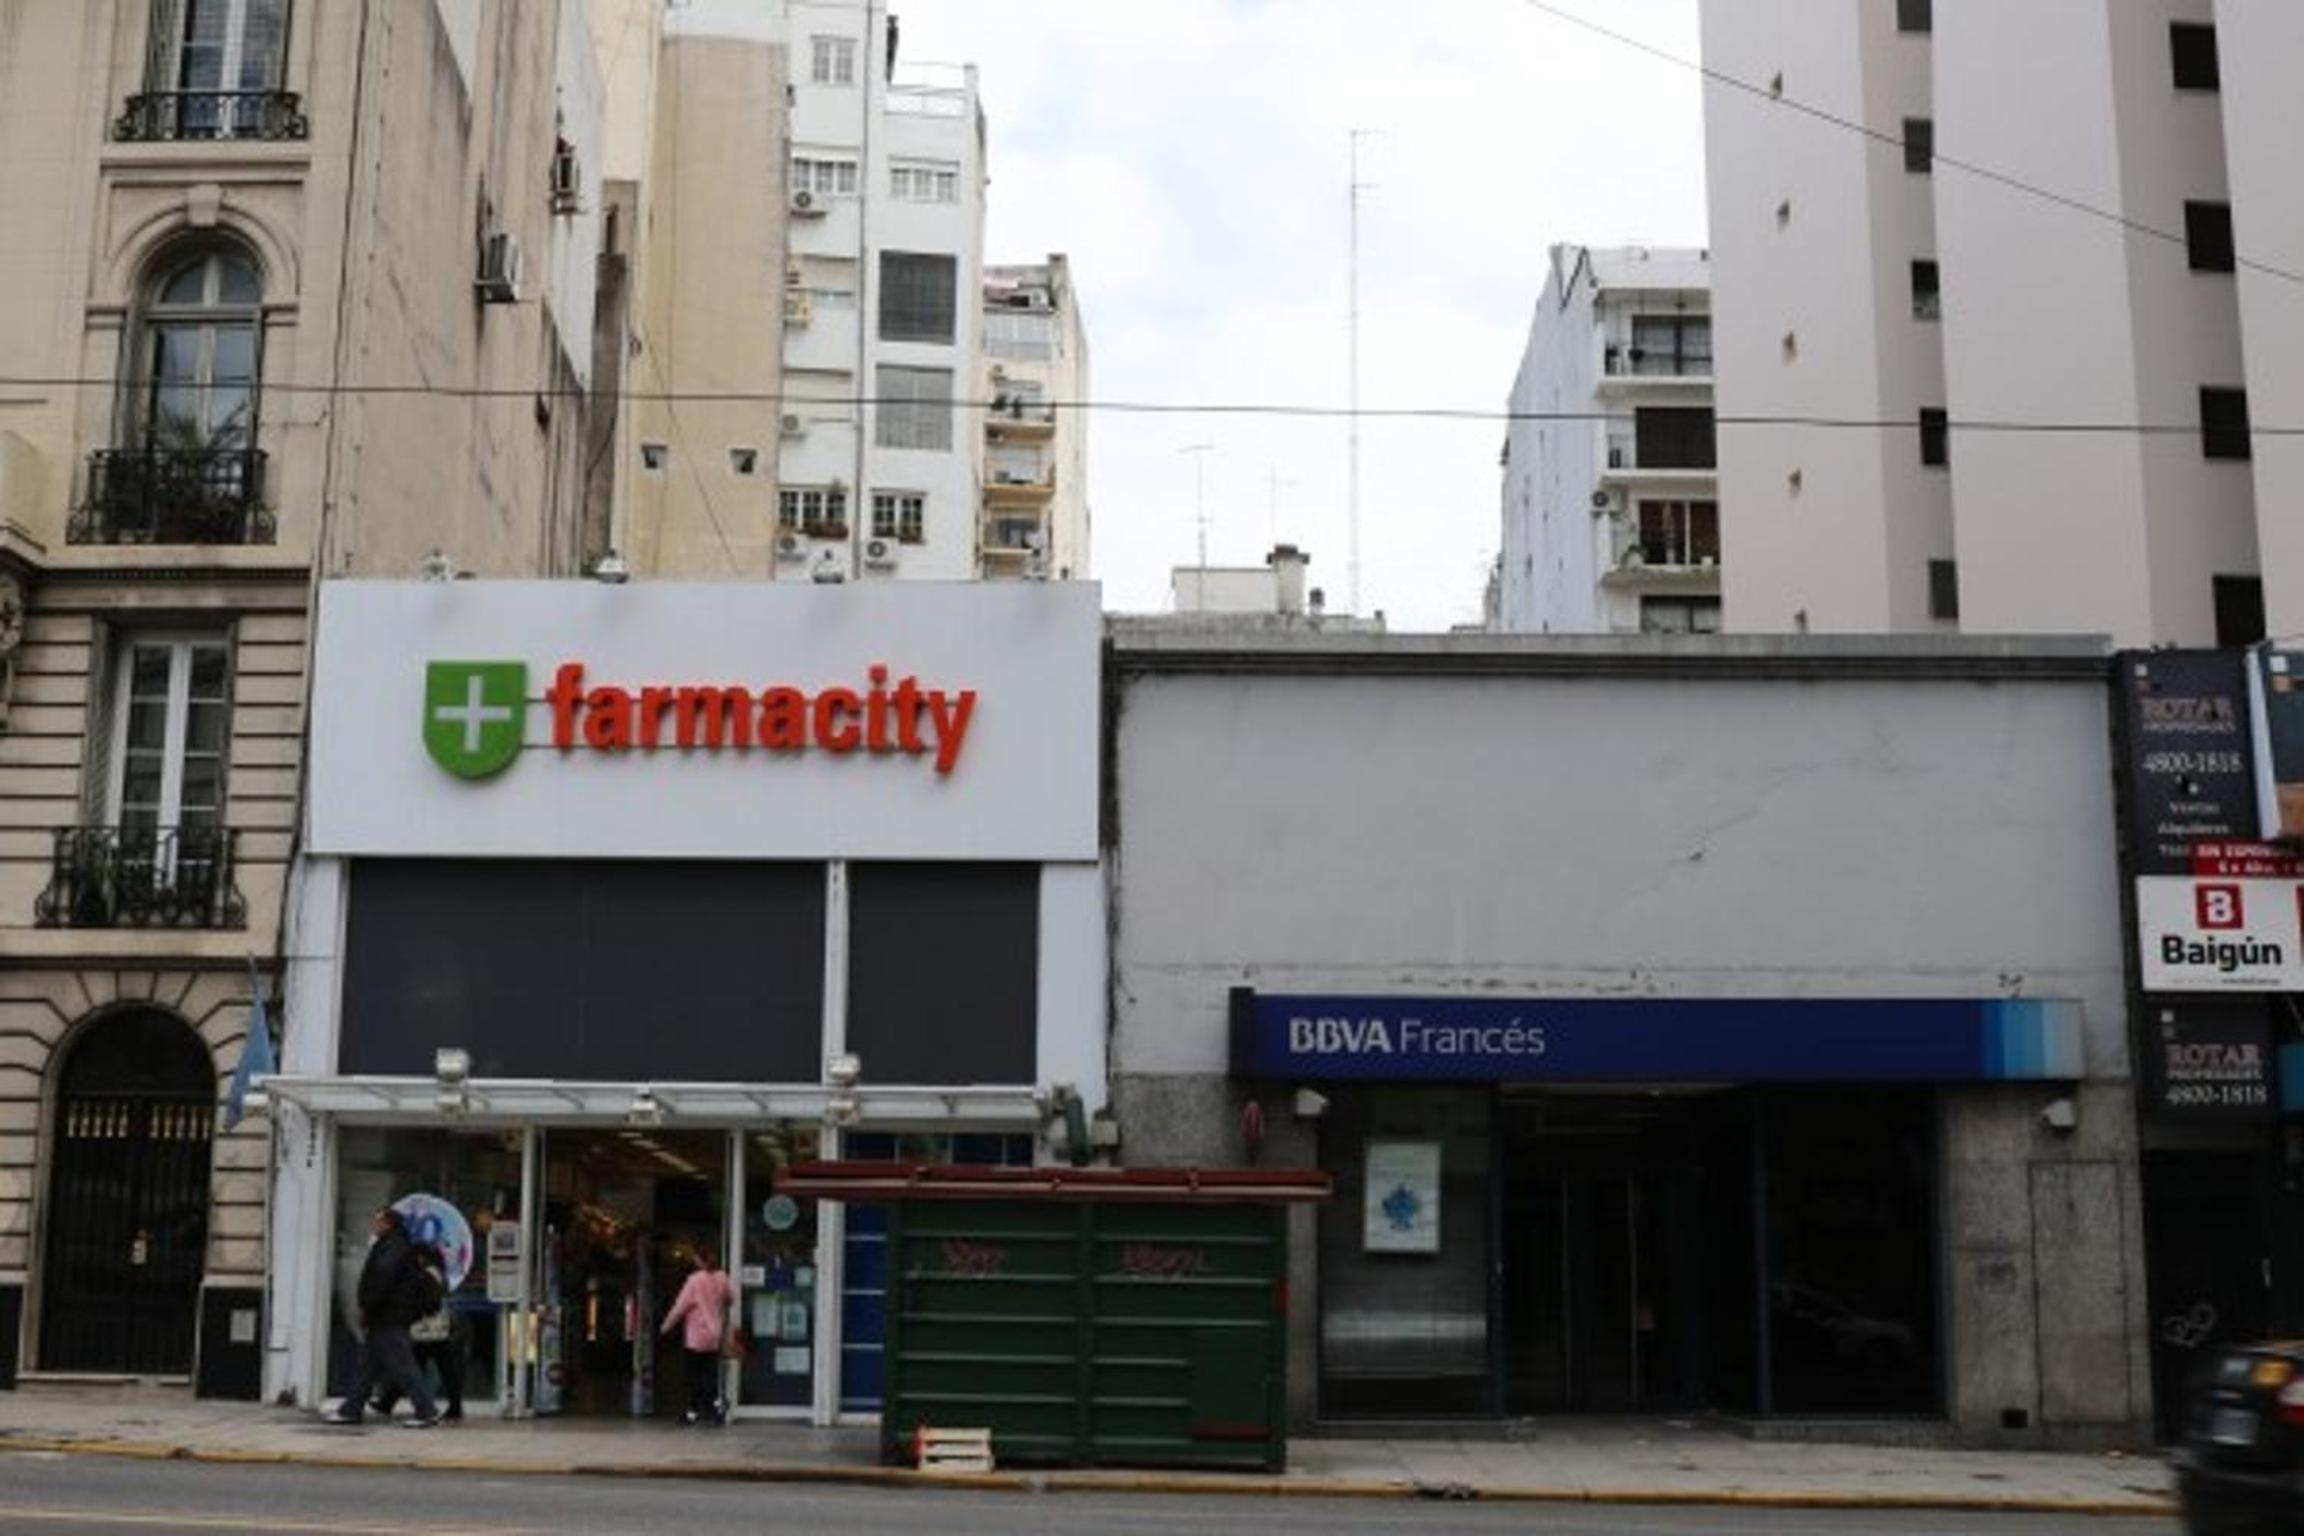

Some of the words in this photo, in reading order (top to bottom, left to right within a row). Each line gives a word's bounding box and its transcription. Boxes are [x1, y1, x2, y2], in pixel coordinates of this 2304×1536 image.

[547, 663, 977, 775] farmacity
[2207, 890, 2235, 923] B
[2161, 935, 2283, 971] Baigún
[1288, 1017, 1393, 1053] BBVA
[1399, 1016, 1546, 1054] Francés
[2165, 1043, 2263, 1068] ROTAR
